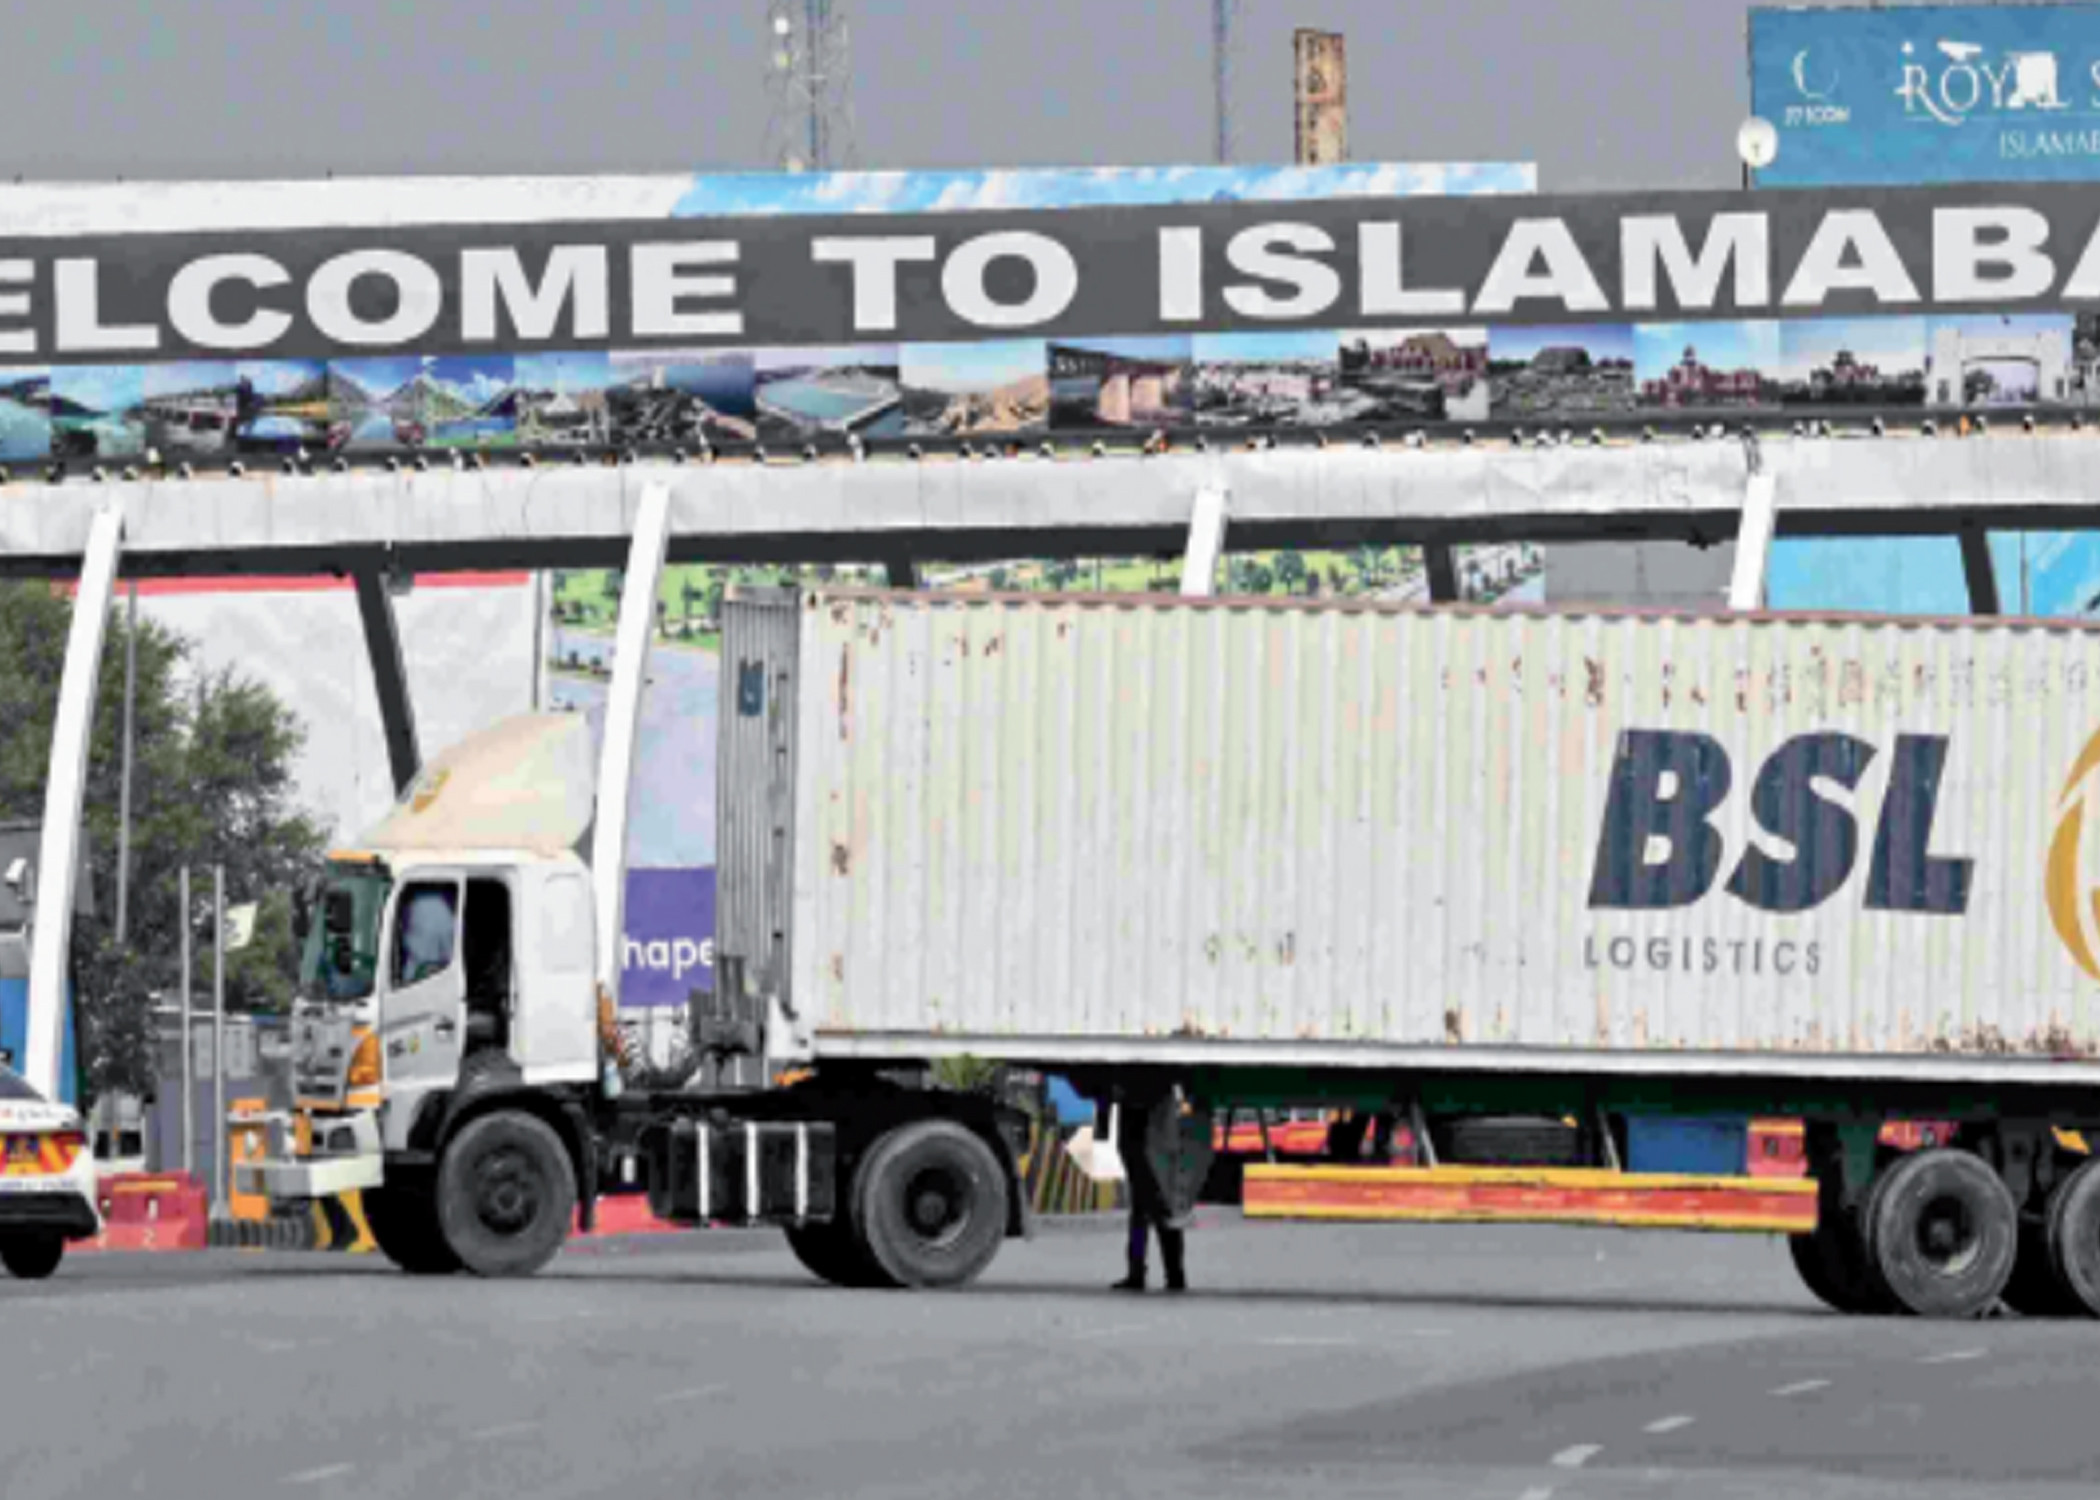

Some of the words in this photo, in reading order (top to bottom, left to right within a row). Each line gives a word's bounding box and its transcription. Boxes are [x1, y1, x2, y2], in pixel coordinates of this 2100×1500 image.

[811, 230, 1077, 332] TO
[1158, 205, 2100, 322] ISLAMAB
[1587, 728, 1975, 914] BSL
[1584, 935, 1821, 975] LOGISTICS
